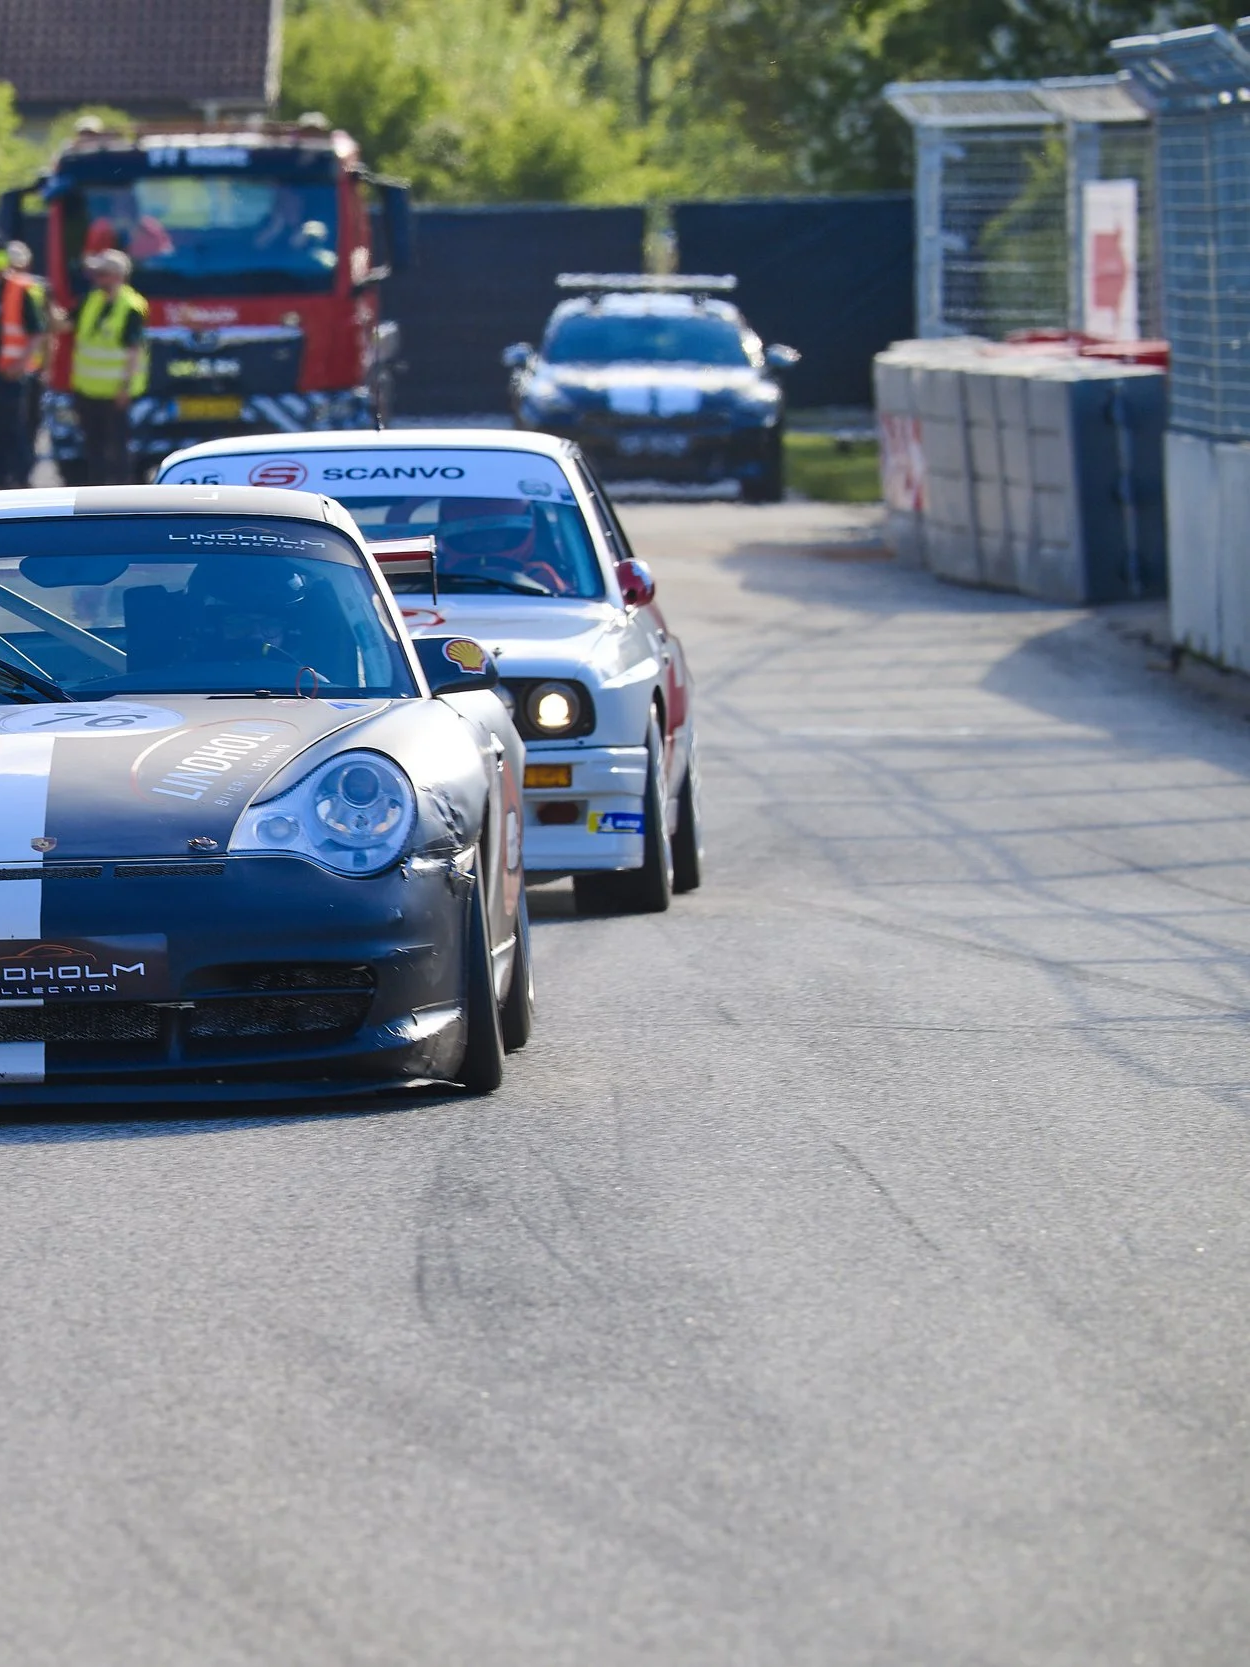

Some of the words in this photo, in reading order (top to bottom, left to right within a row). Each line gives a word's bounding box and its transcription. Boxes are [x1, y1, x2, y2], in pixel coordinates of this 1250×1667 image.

[323, 466, 465, 481] SCANVO
[168, 533, 326, 548] LINDHOLM
[191, 541, 306, 550] COLLECTION
[31, 712, 148, 728] 76
